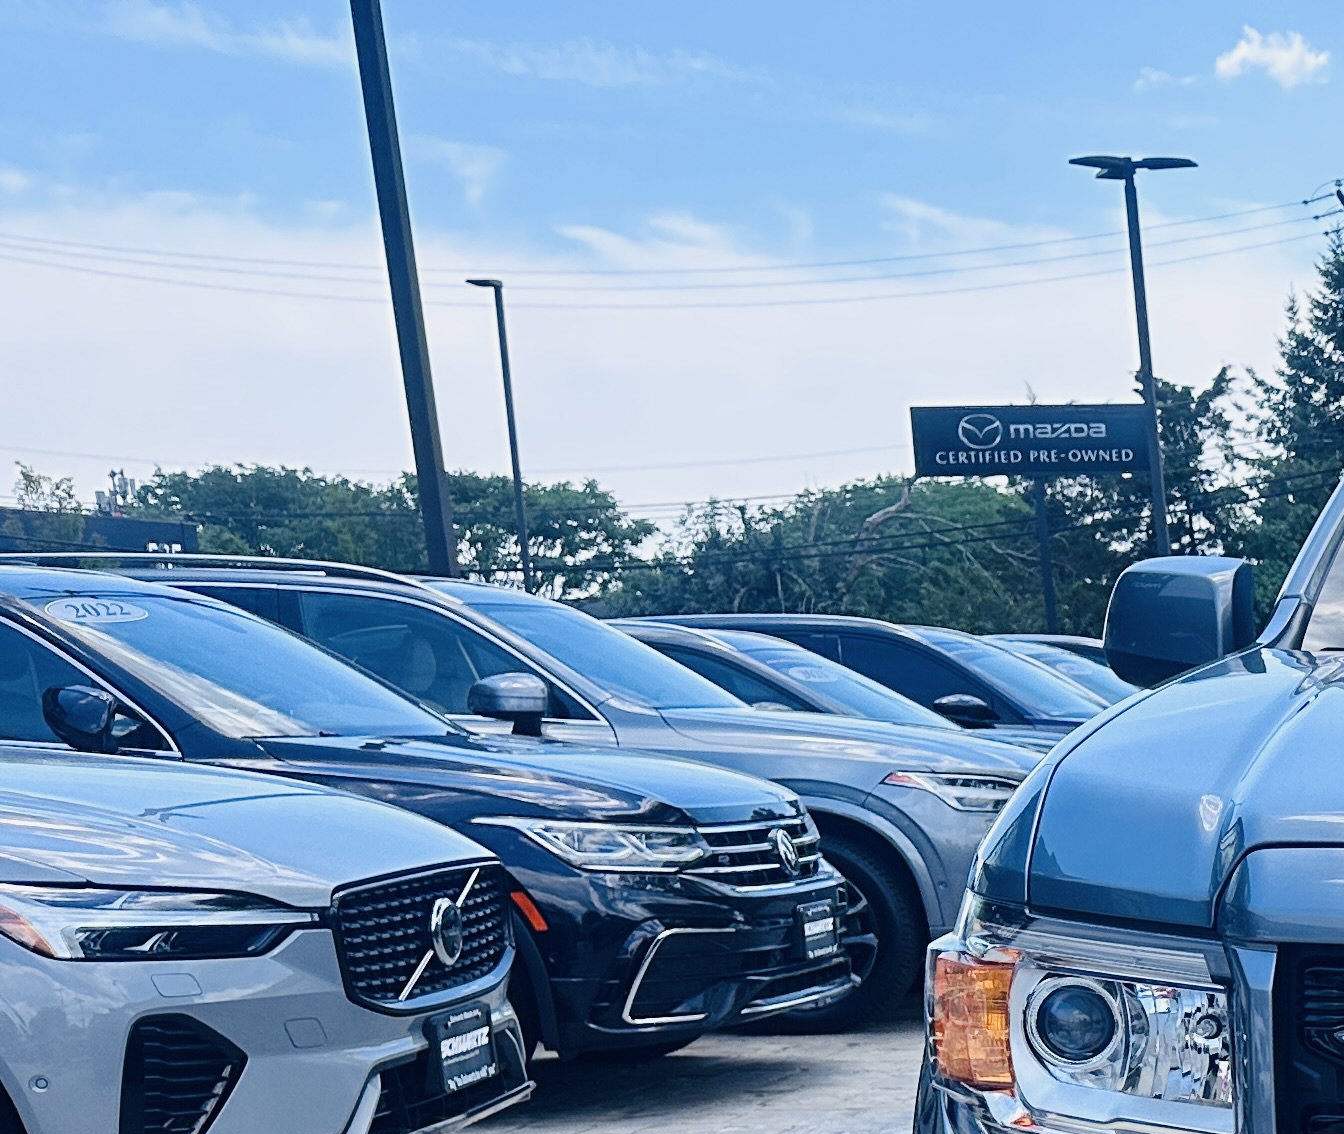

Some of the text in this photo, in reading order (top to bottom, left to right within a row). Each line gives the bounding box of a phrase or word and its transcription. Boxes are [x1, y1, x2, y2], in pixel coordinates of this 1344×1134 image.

[1009, 422, 1107, 439] mazda
[935, 448, 1134, 465] CERTIFIED PRE-OWNED
[64, 602, 131, 619] 2022
